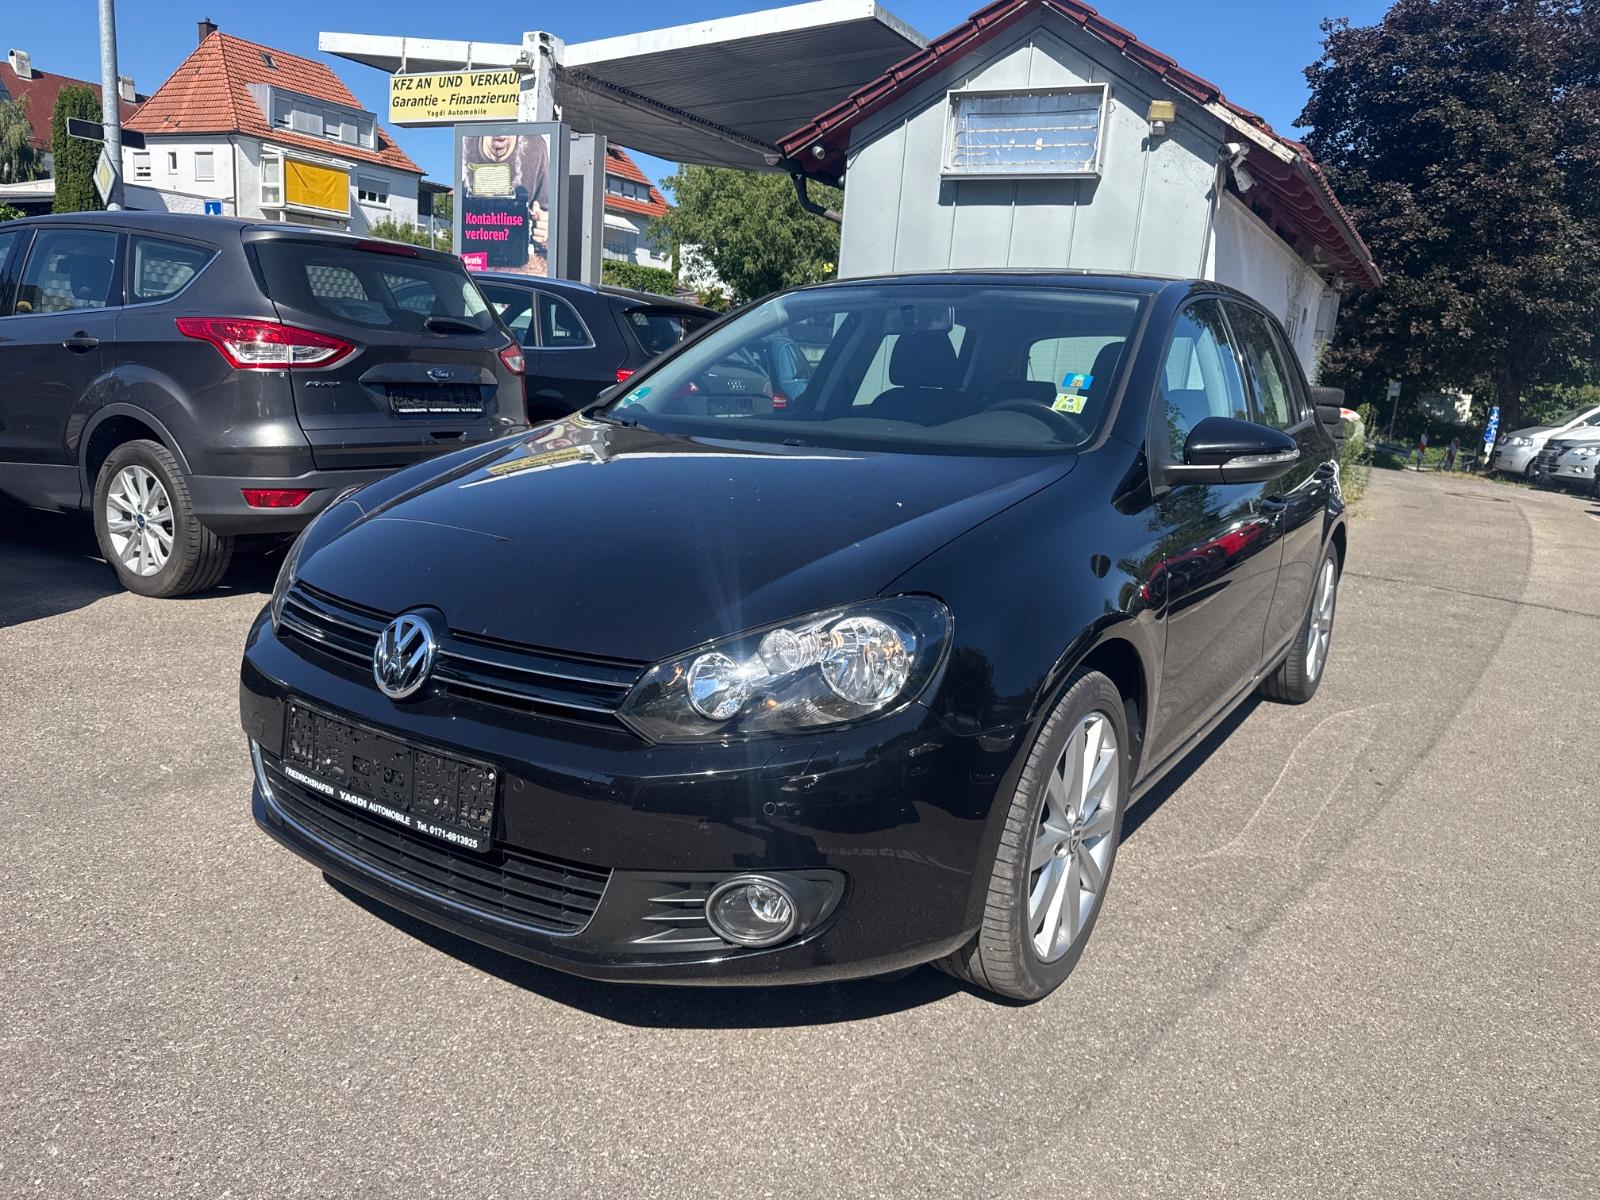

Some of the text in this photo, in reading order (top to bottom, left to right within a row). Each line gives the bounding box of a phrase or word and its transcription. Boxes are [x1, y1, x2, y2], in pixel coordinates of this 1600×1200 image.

[392, 78, 413, 91] KFZ
[415, 77, 432, 90] AN
[438, 75, 463, 89] UND
[392, 94, 438, 108] Garantie
[427, 108, 487, 117] Yagdi Automobile
[465, 212, 523, 225] Kontaktlinse
[465, 227, 509, 240] verloren?
[285, 766, 478, 849] FRIEDRICHSHAFEN YAGDI AUTOMOBILE Tel. 0171-6913925
